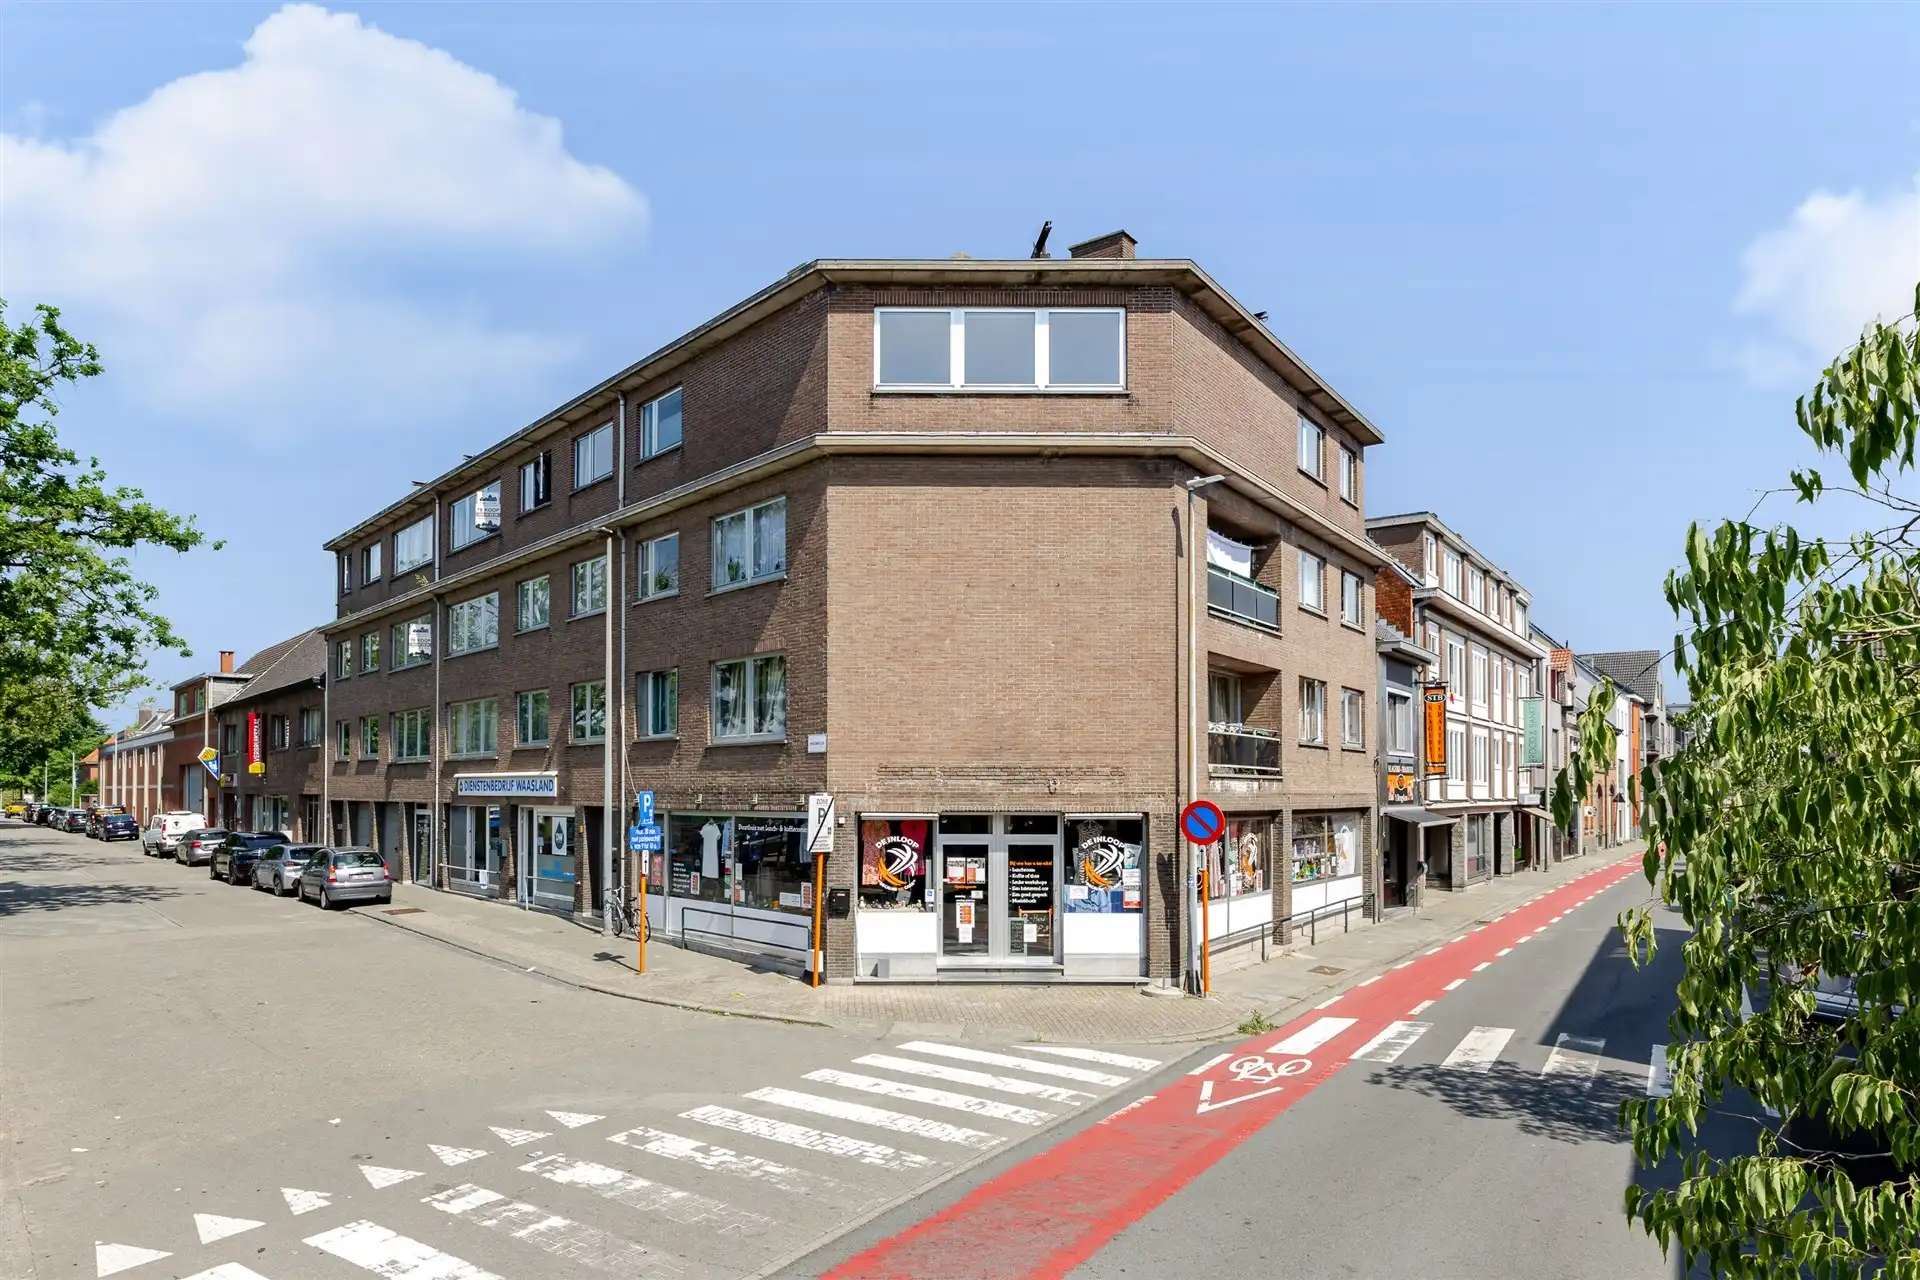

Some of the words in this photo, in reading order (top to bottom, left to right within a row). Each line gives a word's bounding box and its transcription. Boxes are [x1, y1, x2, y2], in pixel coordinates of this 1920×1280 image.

[1528, 737, 1538, 763] BROOD
[464, 780, 514, 792] DIENSTENBEDRIJF
[516, 779, 554, 792] WAASLAND
[643, 794, 652, 813] P
[875, 839, 887, 849] DE
[887, 836, 919, 848] INLOOP
[1081, 838, 1094, 849] DE
[1093, 836, 1125, 848] INLOOP
